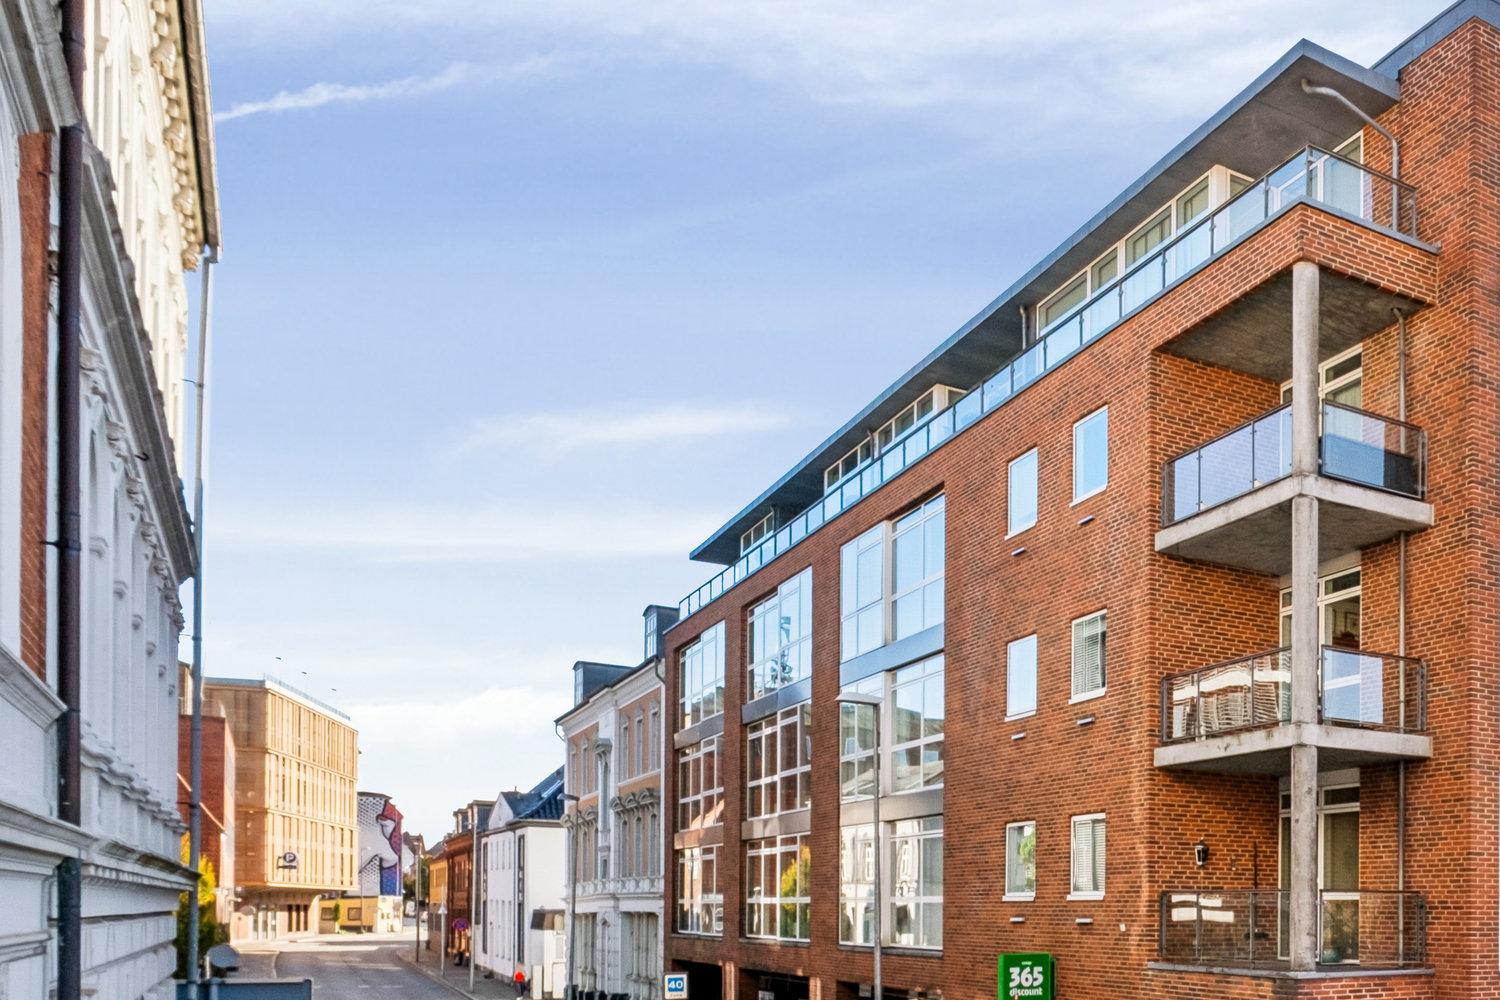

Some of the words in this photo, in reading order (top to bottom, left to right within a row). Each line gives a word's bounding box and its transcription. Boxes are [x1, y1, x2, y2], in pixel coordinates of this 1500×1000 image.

[1009, 966, 1044, 988] 365
[668, 980, 684, 989] 40
[1009, 987, 1043, 997] discount
